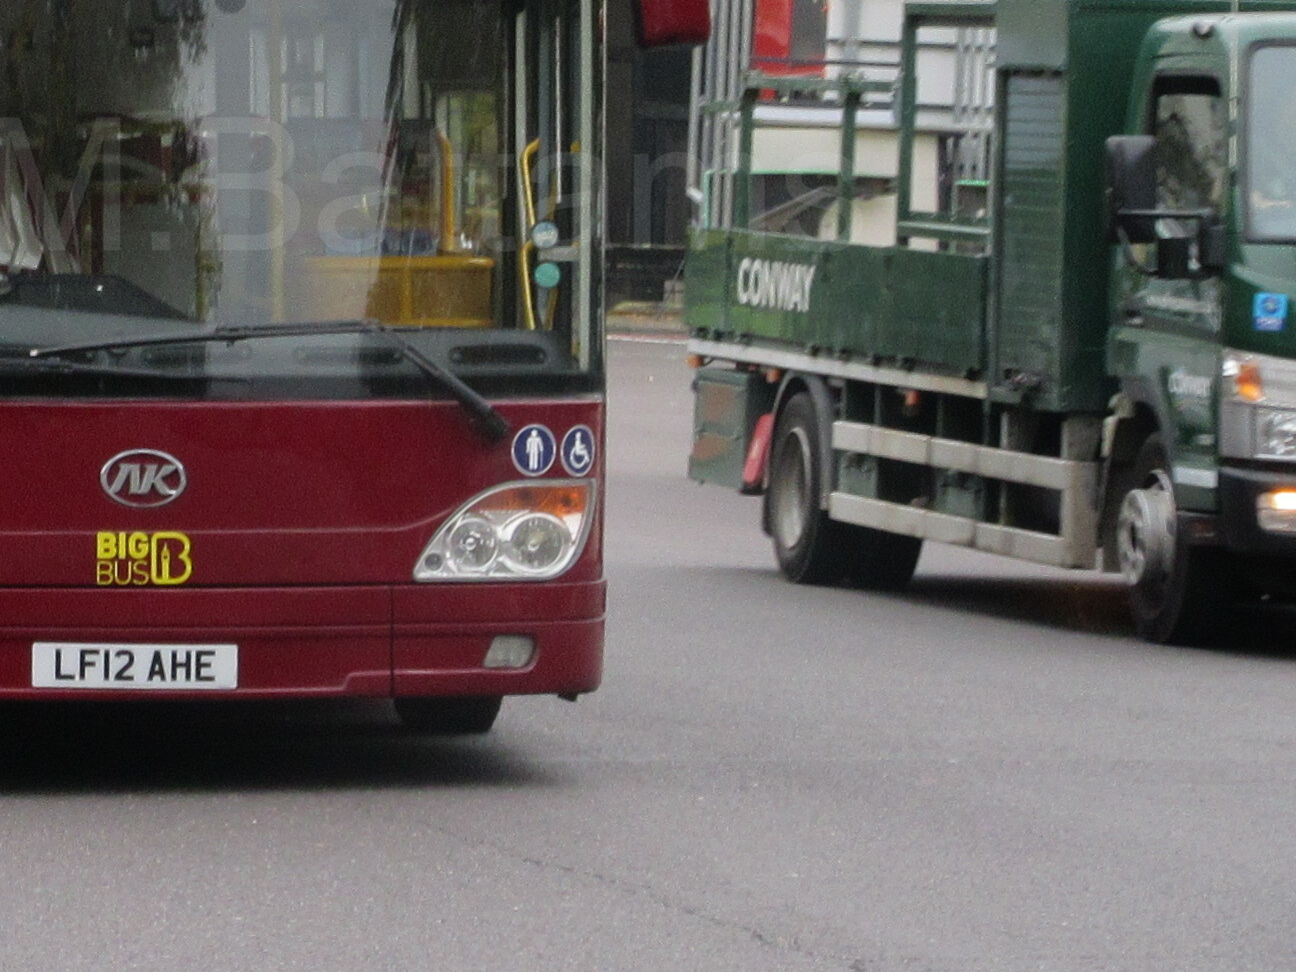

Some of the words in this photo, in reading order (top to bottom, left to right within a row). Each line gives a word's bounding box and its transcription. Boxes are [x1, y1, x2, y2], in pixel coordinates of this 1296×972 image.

[737, 257, 816, 313] CONWAY
[97, 531, 149, 560] BIG
[96, 561, 149, 586] BUS
[55, 648, 134, 681] LF12
[147, 650, 216, 682] AHE
